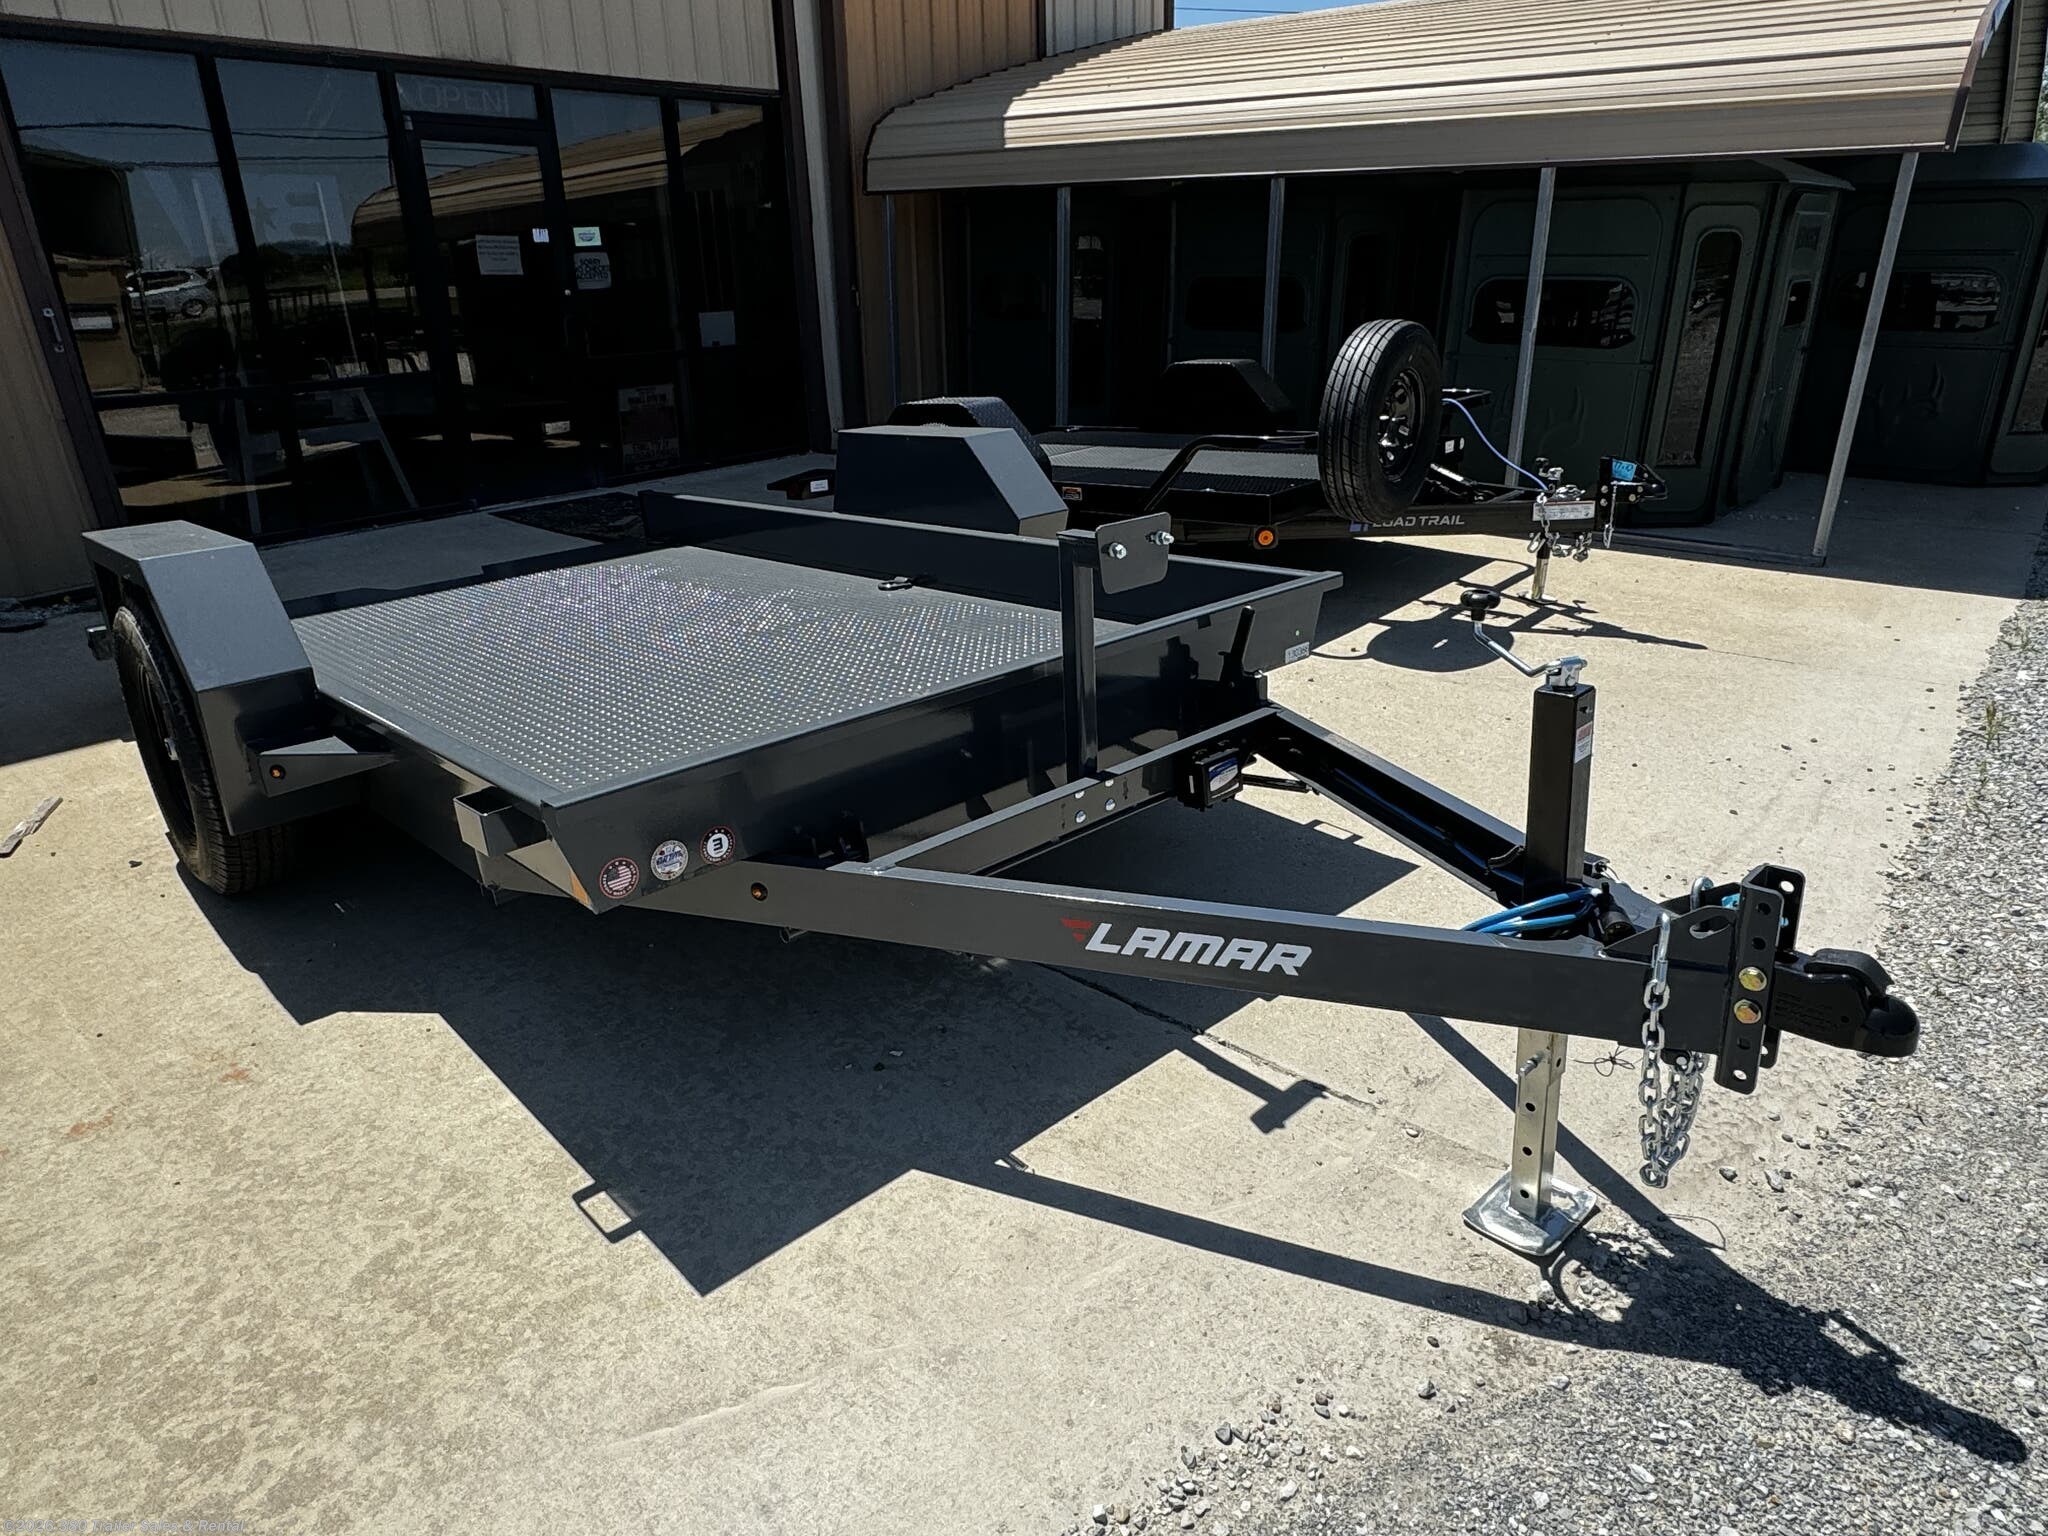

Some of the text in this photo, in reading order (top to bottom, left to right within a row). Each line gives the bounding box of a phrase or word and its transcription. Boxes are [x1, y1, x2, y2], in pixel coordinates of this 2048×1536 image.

[417, 81, 503, 113] OPEN
[1419, 515, 1465, 526] TRAIL
[1085, 922, 1313, 977] LAMAR
